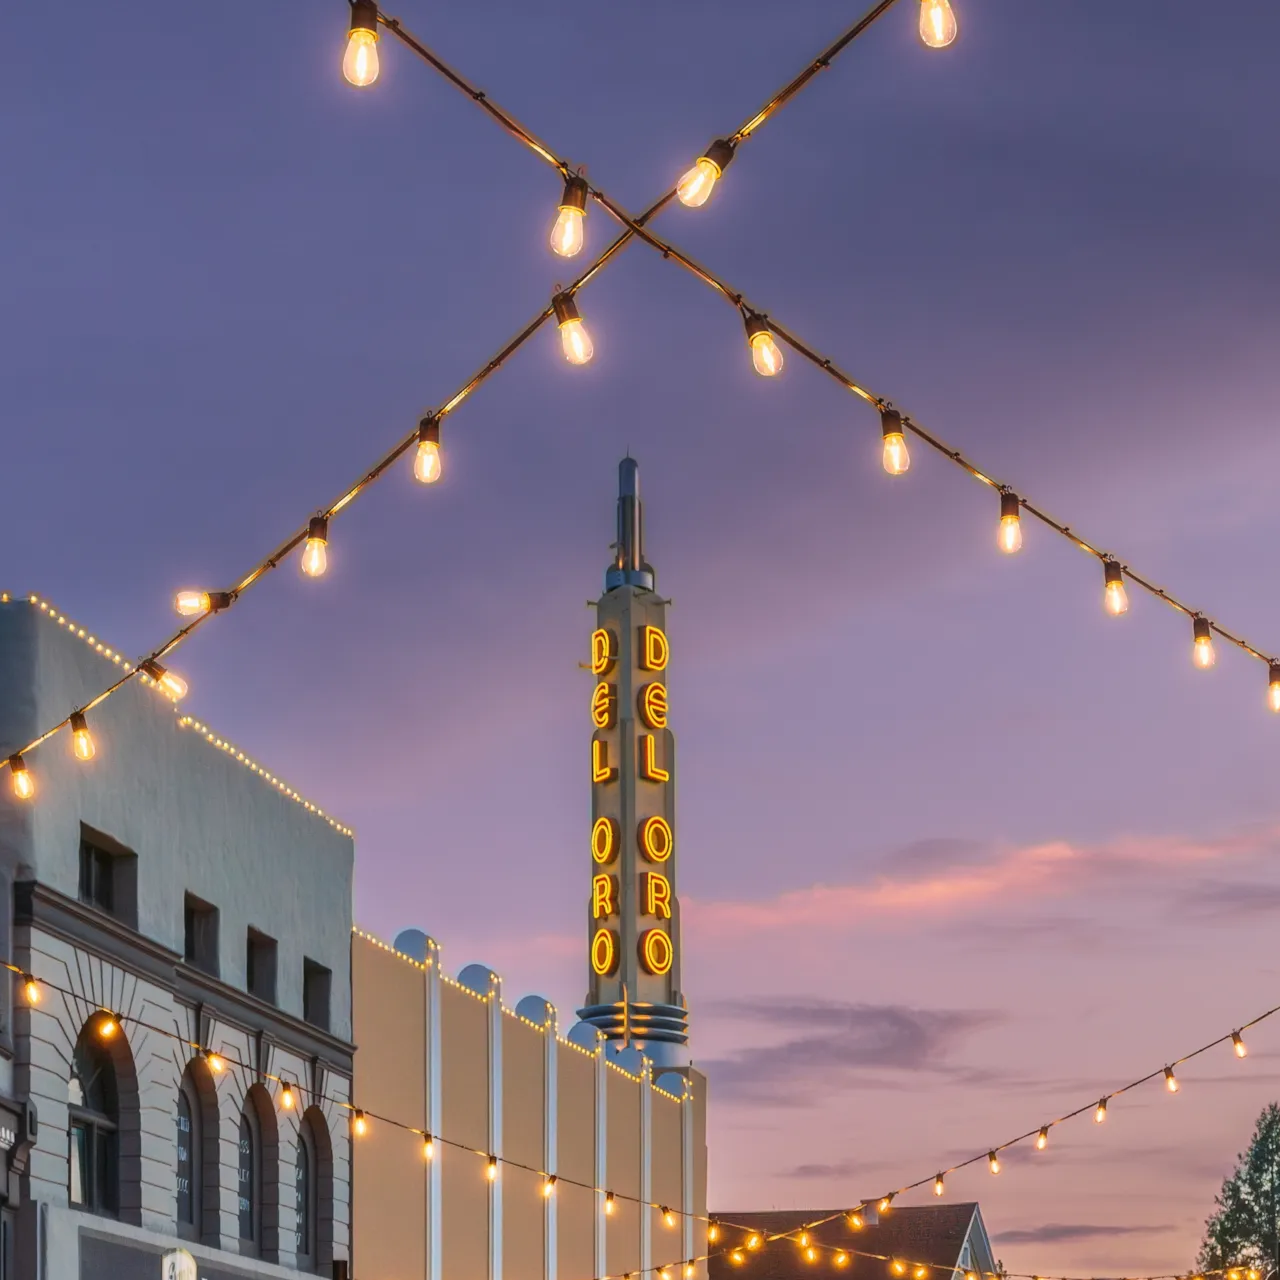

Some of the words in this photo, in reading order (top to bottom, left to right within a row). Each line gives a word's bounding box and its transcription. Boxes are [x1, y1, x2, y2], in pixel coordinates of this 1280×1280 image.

[590, 625, 619, 783] DEL
[638, 624, 670, 783] DEL
[589, 815, 621, 977] ORO
[637, 814, 674, 977] ORO
